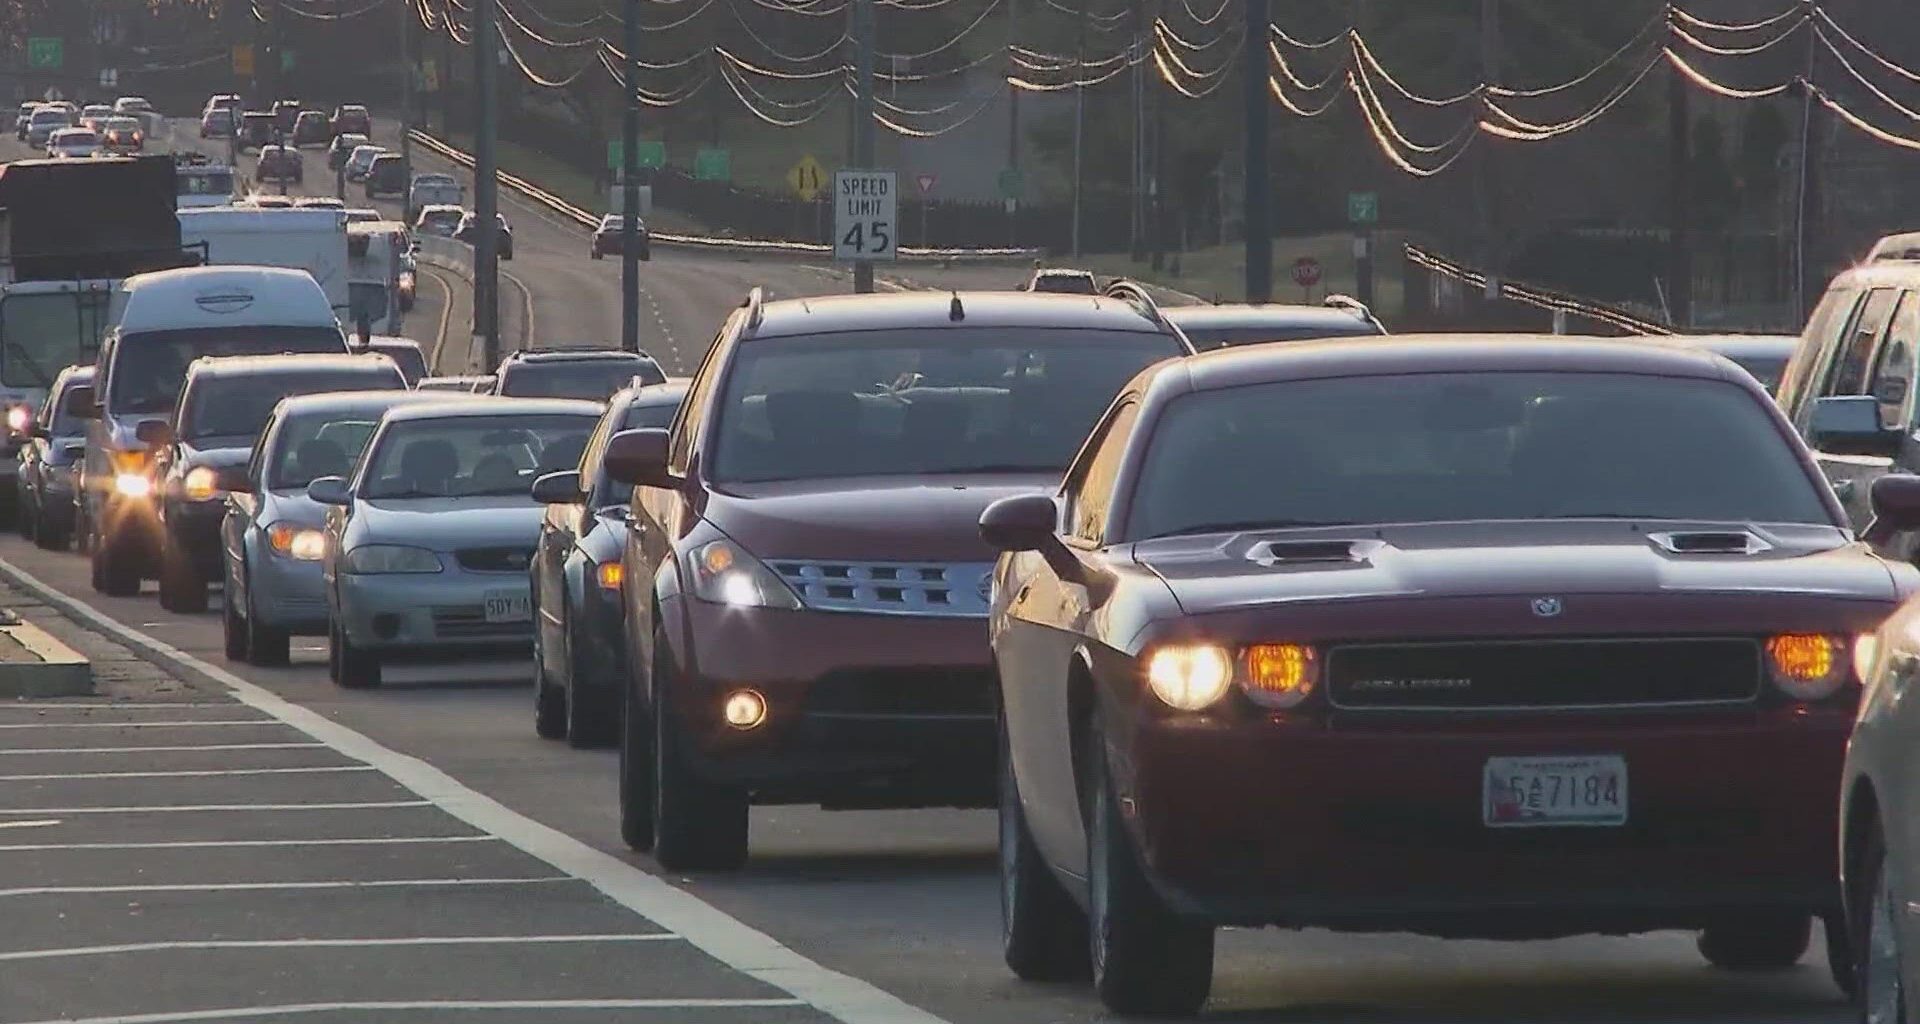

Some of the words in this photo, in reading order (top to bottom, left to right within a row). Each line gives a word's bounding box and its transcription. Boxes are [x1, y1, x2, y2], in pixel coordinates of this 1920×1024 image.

[842, 179, 887, 195] SPEED
[848, 199, 881, 215] LIMIT
[842, 221, 889, 253] 45
